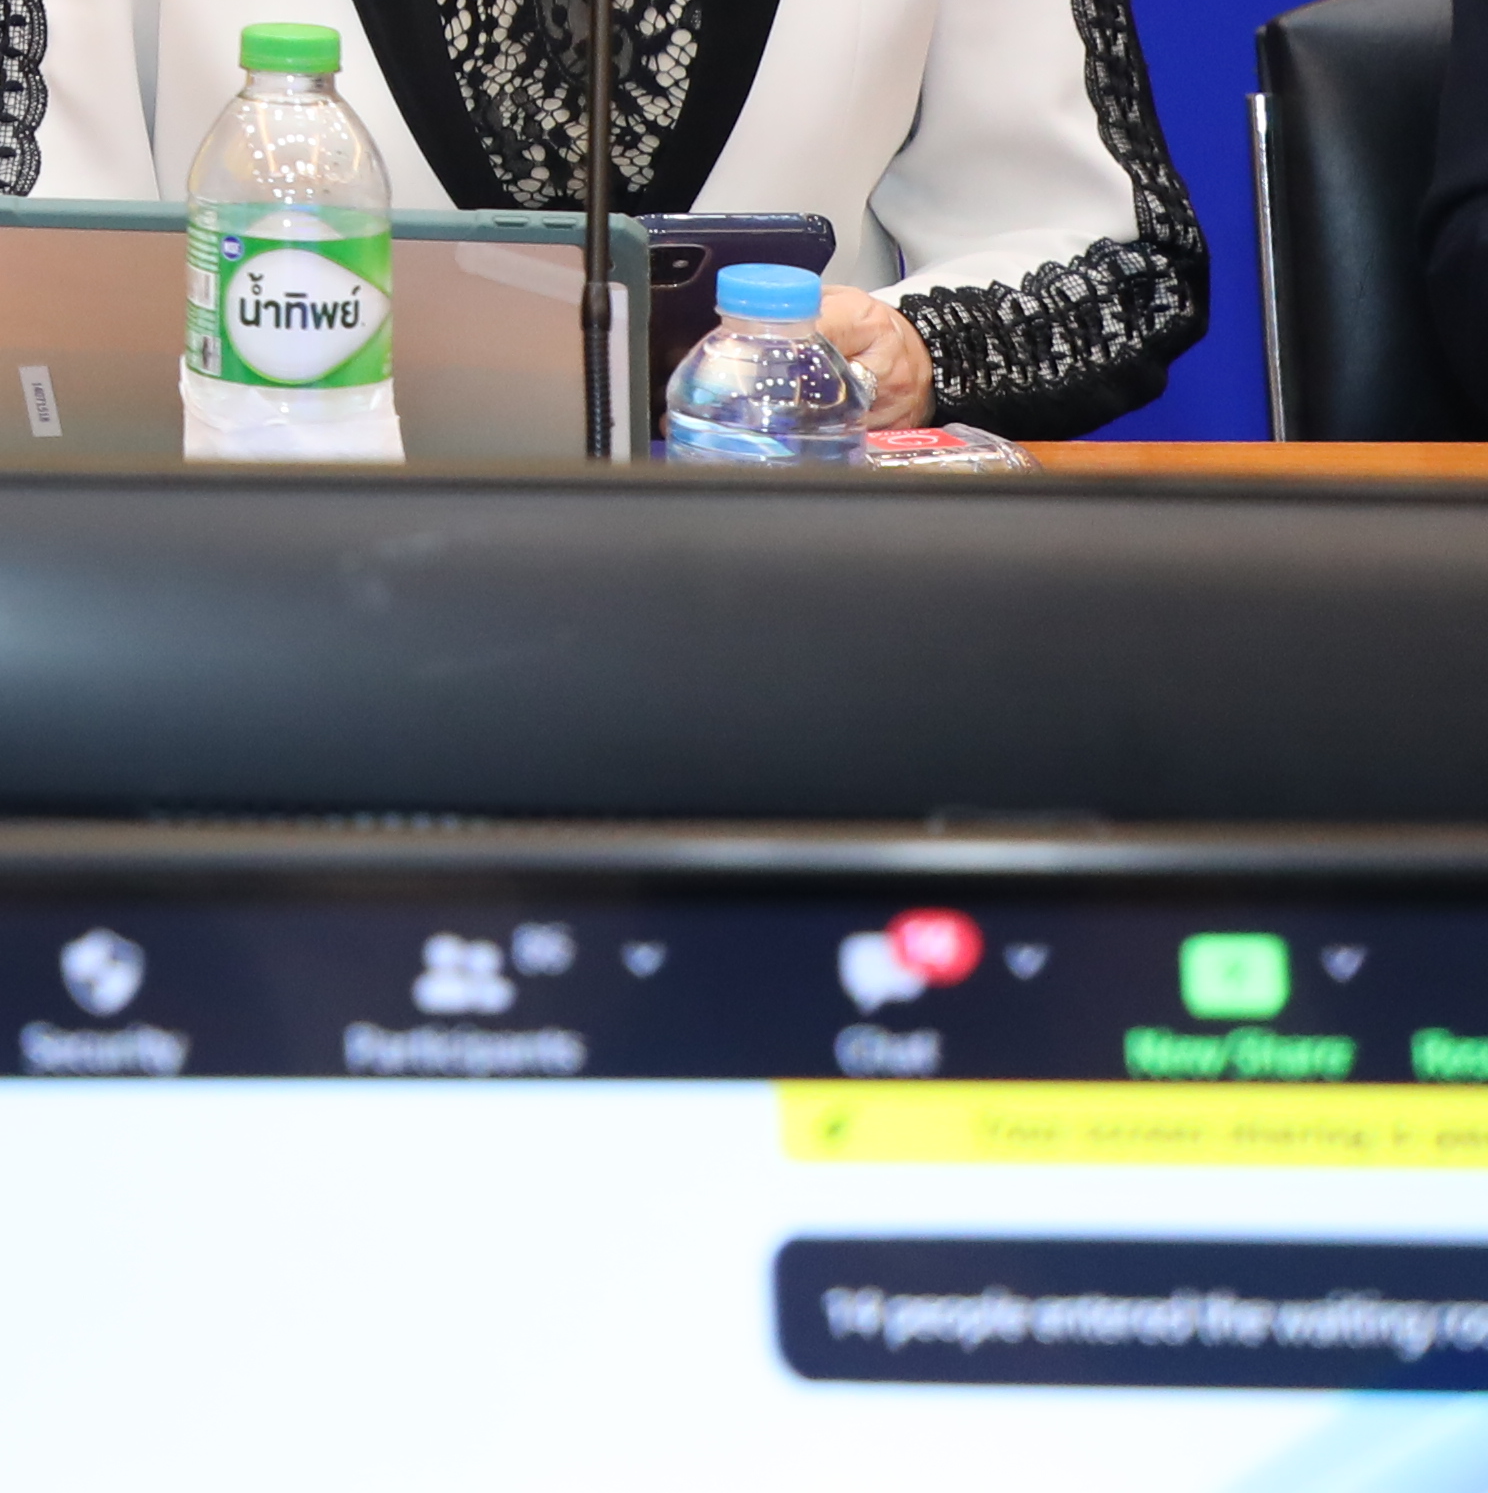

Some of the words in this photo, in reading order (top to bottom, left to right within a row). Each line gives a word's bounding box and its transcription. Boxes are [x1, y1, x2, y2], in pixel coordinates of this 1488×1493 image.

[238, 271, 361, 330] น้ำทิพย์
[343, 1020, 587, 1076] Participants
[835, 1024, 941, 1077] Chat
[1228, 1025, 1357, 1080] Share
[884, 1286, 1032, 1354] people
[1032, 1289, 1199, 1347] entered
[1196, 1287, 1273, 1348] the
[1272, 1288, 1436, 1363] waiting
